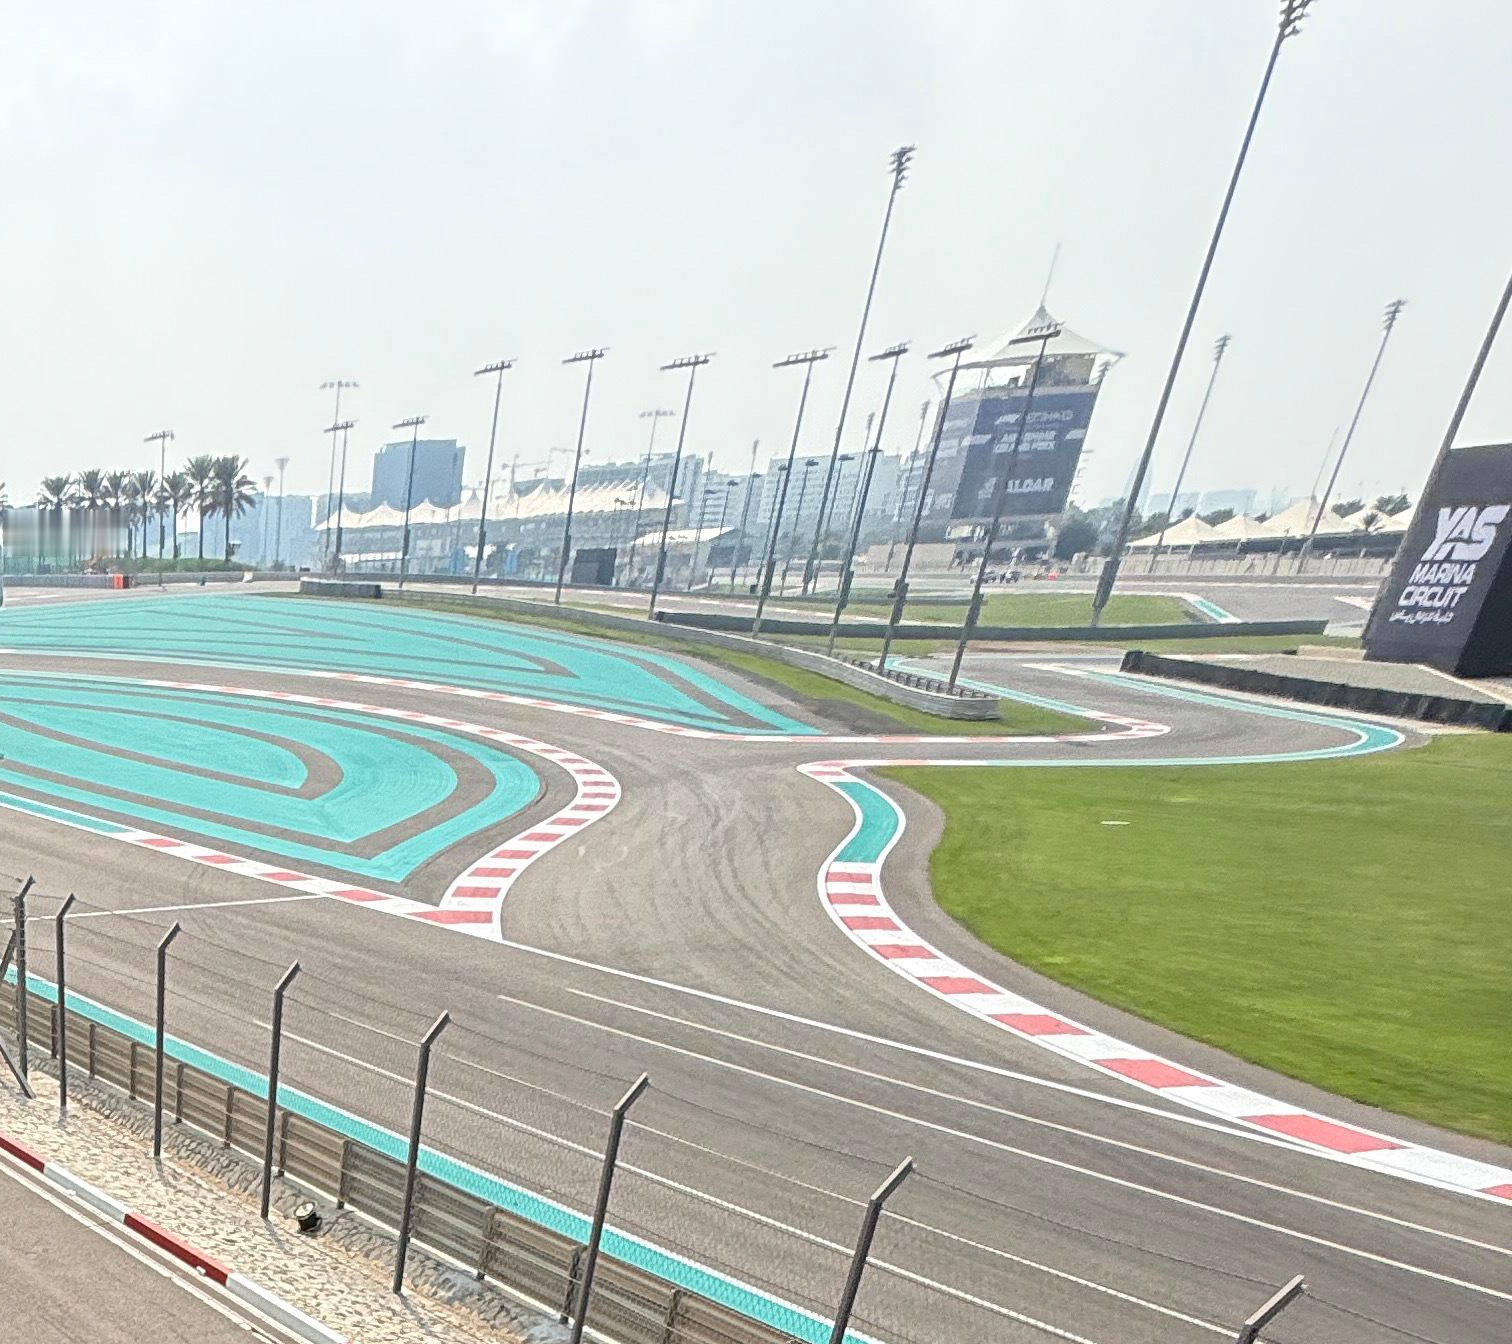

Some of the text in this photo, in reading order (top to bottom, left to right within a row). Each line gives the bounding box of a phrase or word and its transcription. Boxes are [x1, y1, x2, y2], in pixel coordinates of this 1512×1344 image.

[1420, 504, 1510, 561] YAS
[1408, 562, 1477, 585] MARINA
[1397, 585, 1469, 609] CIRCUIT
